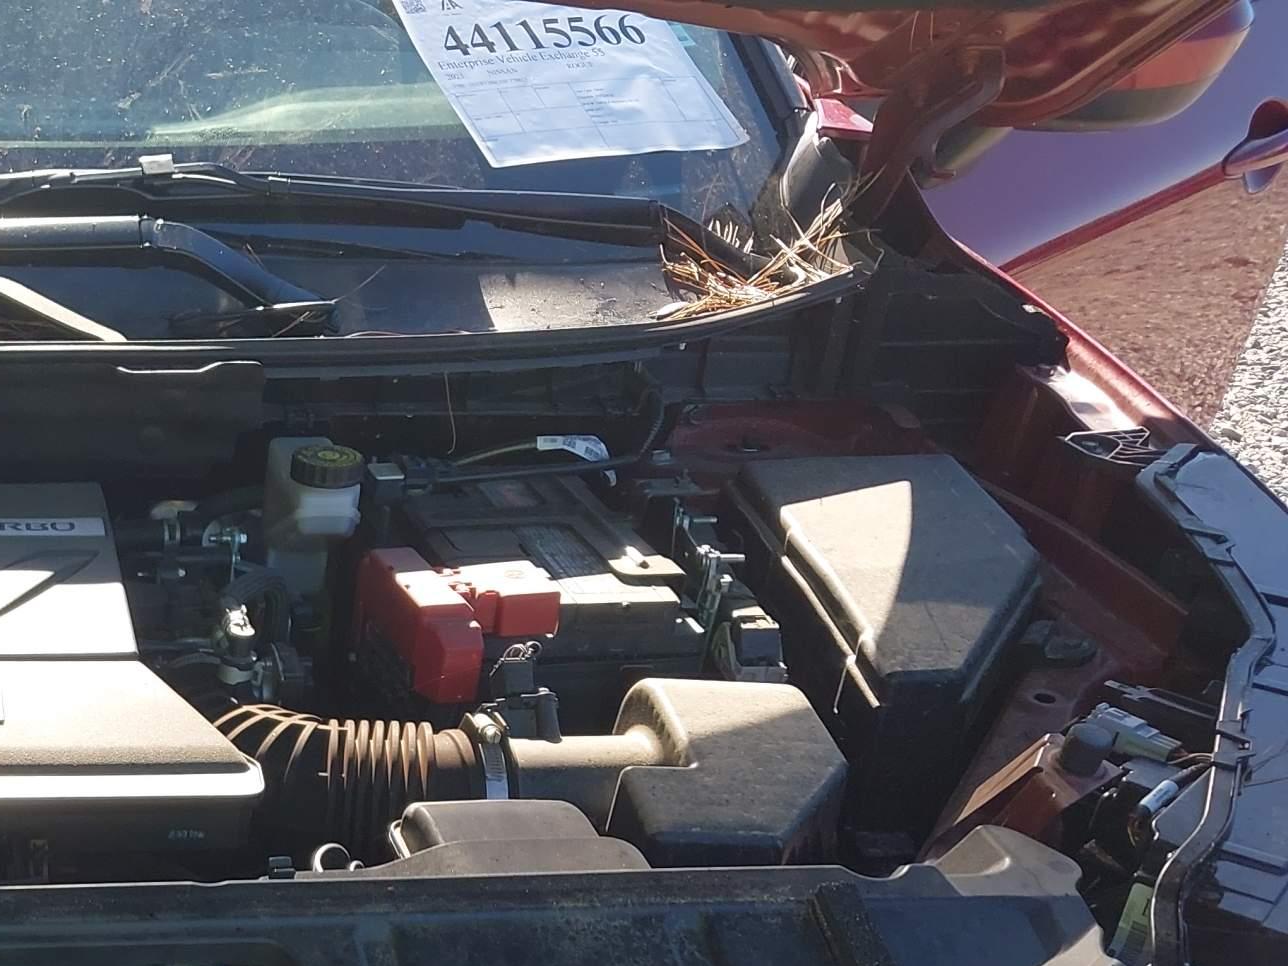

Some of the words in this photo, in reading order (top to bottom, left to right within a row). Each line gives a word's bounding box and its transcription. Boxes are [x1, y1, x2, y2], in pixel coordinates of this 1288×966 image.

[443, 14, 646, 56] 44115566
[438, 57, 494, 71] Enterprise
[495, 52, 538, 65] Vehicle
[540, 49, 590, 62] Exchange
